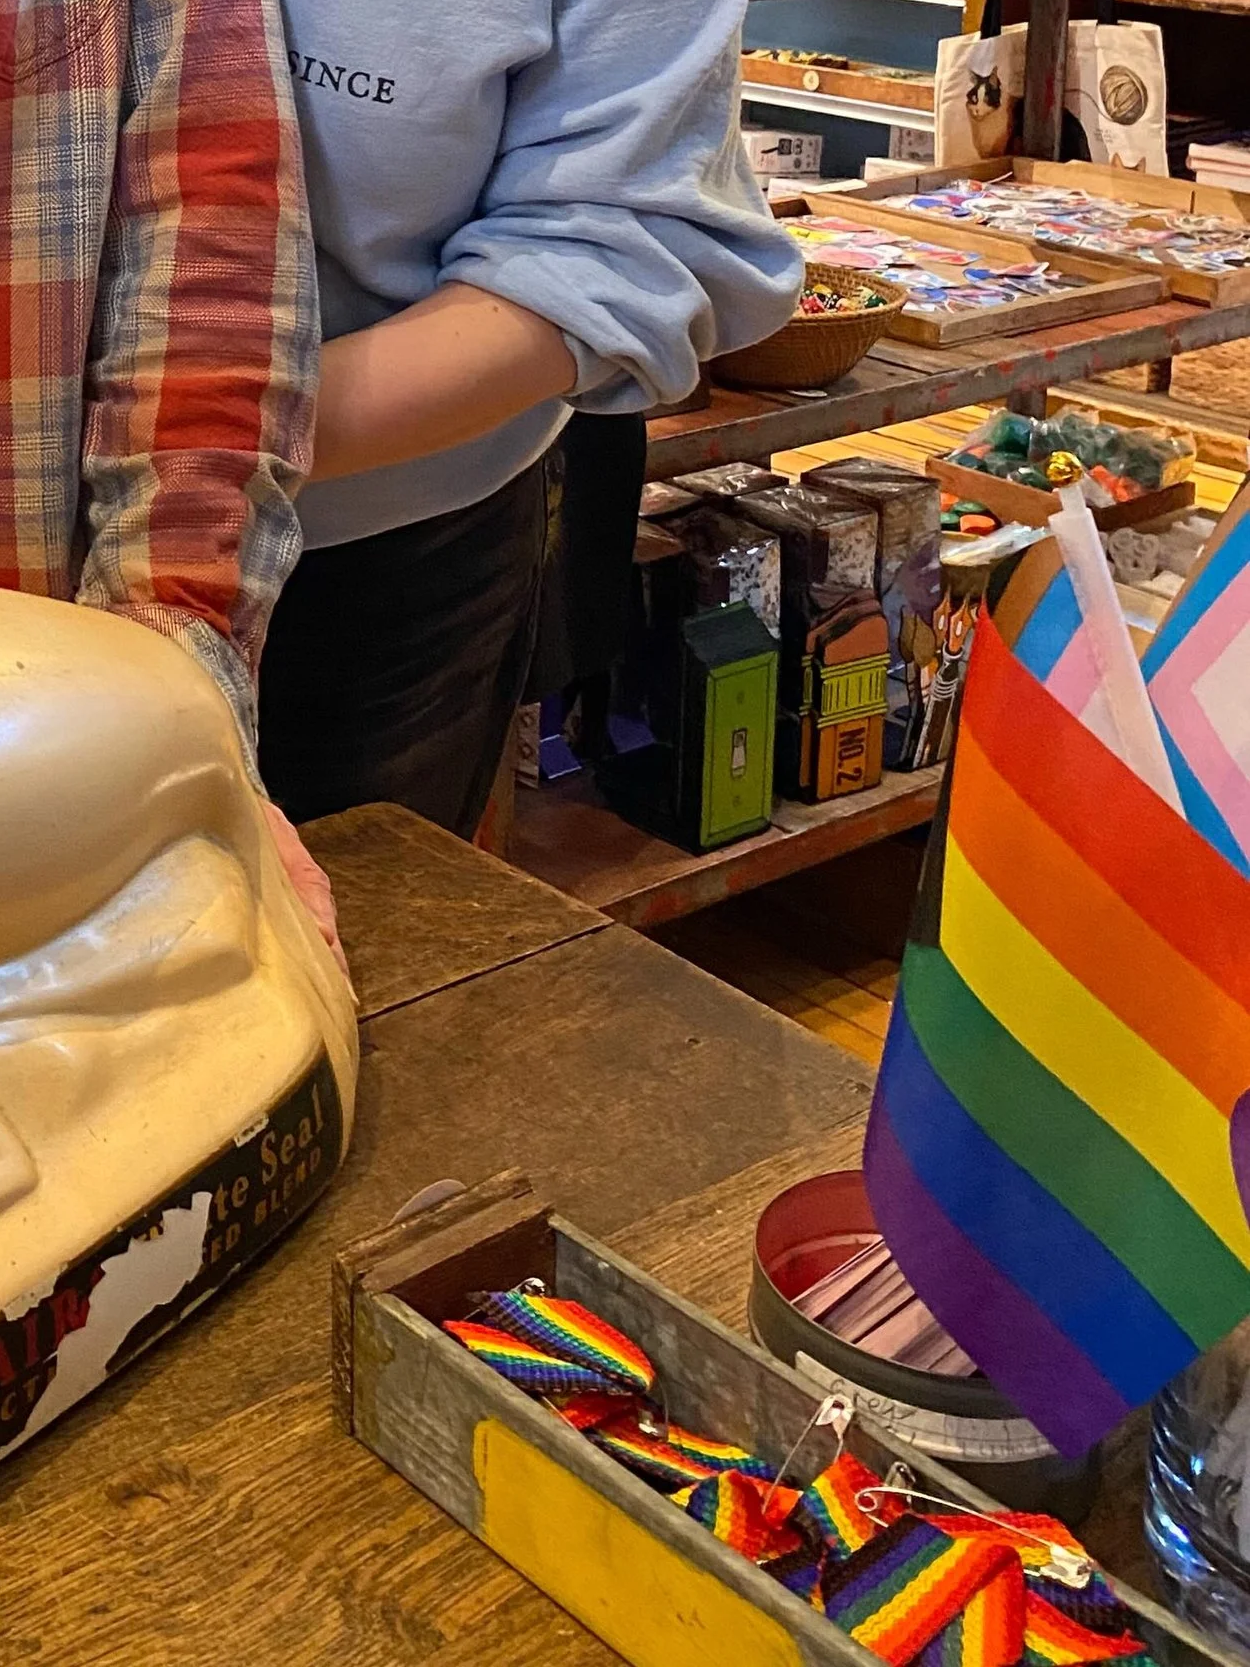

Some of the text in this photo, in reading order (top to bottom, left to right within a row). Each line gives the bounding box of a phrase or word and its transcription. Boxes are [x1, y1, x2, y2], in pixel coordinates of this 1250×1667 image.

[288, 50, 395, 104] SINCE
[836, 727, 866, 786] NO.2
[261, 1083, 324, 1185] Seal
